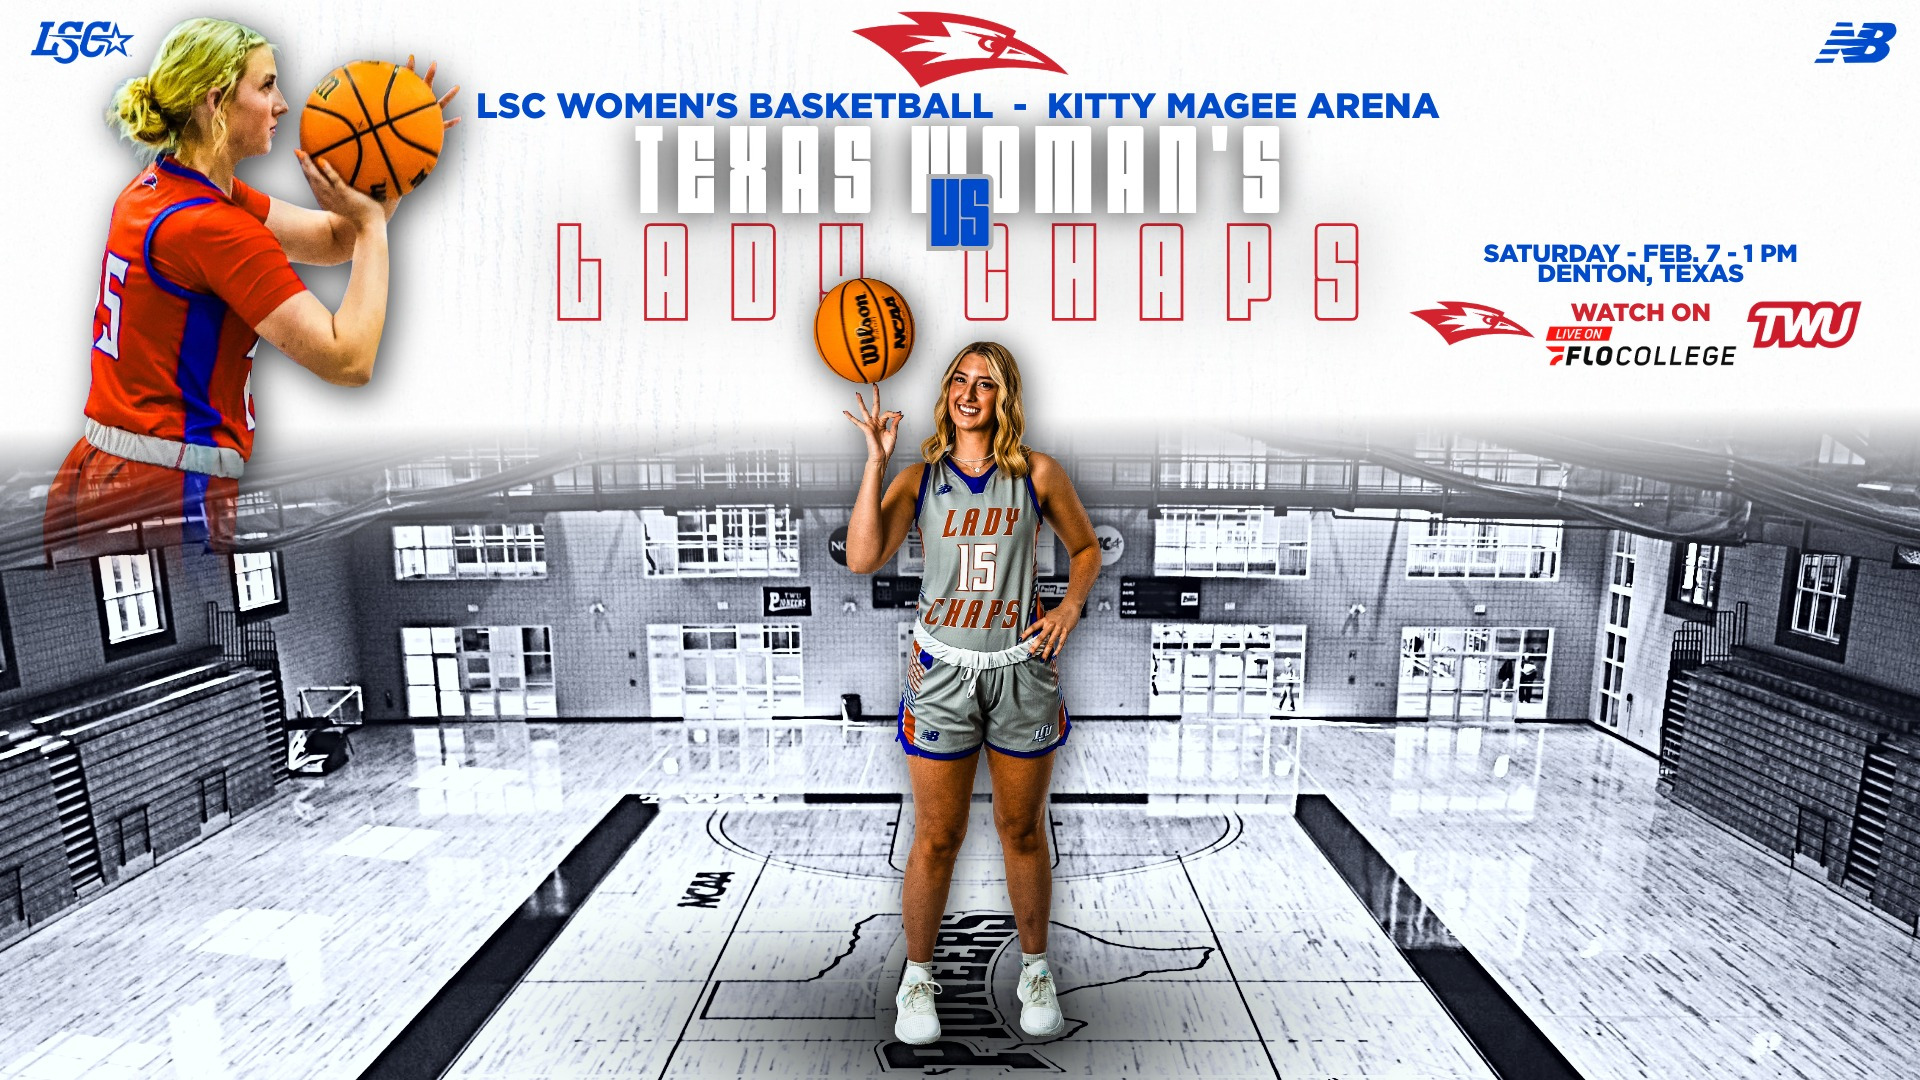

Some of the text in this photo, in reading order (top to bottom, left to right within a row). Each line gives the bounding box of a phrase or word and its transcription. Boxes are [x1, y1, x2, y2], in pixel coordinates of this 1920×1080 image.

[92, 251, 131, 362] 5
[855, 293, 880, 367] Wilson
[883, 296, 907, 350] NCAA
[942, 507, 1021, 538] LADY
[955, 543, 998, 592] 15
[924, 598, 1022, 629] CHAPS
[676, 871, 736, 909] NCAA
